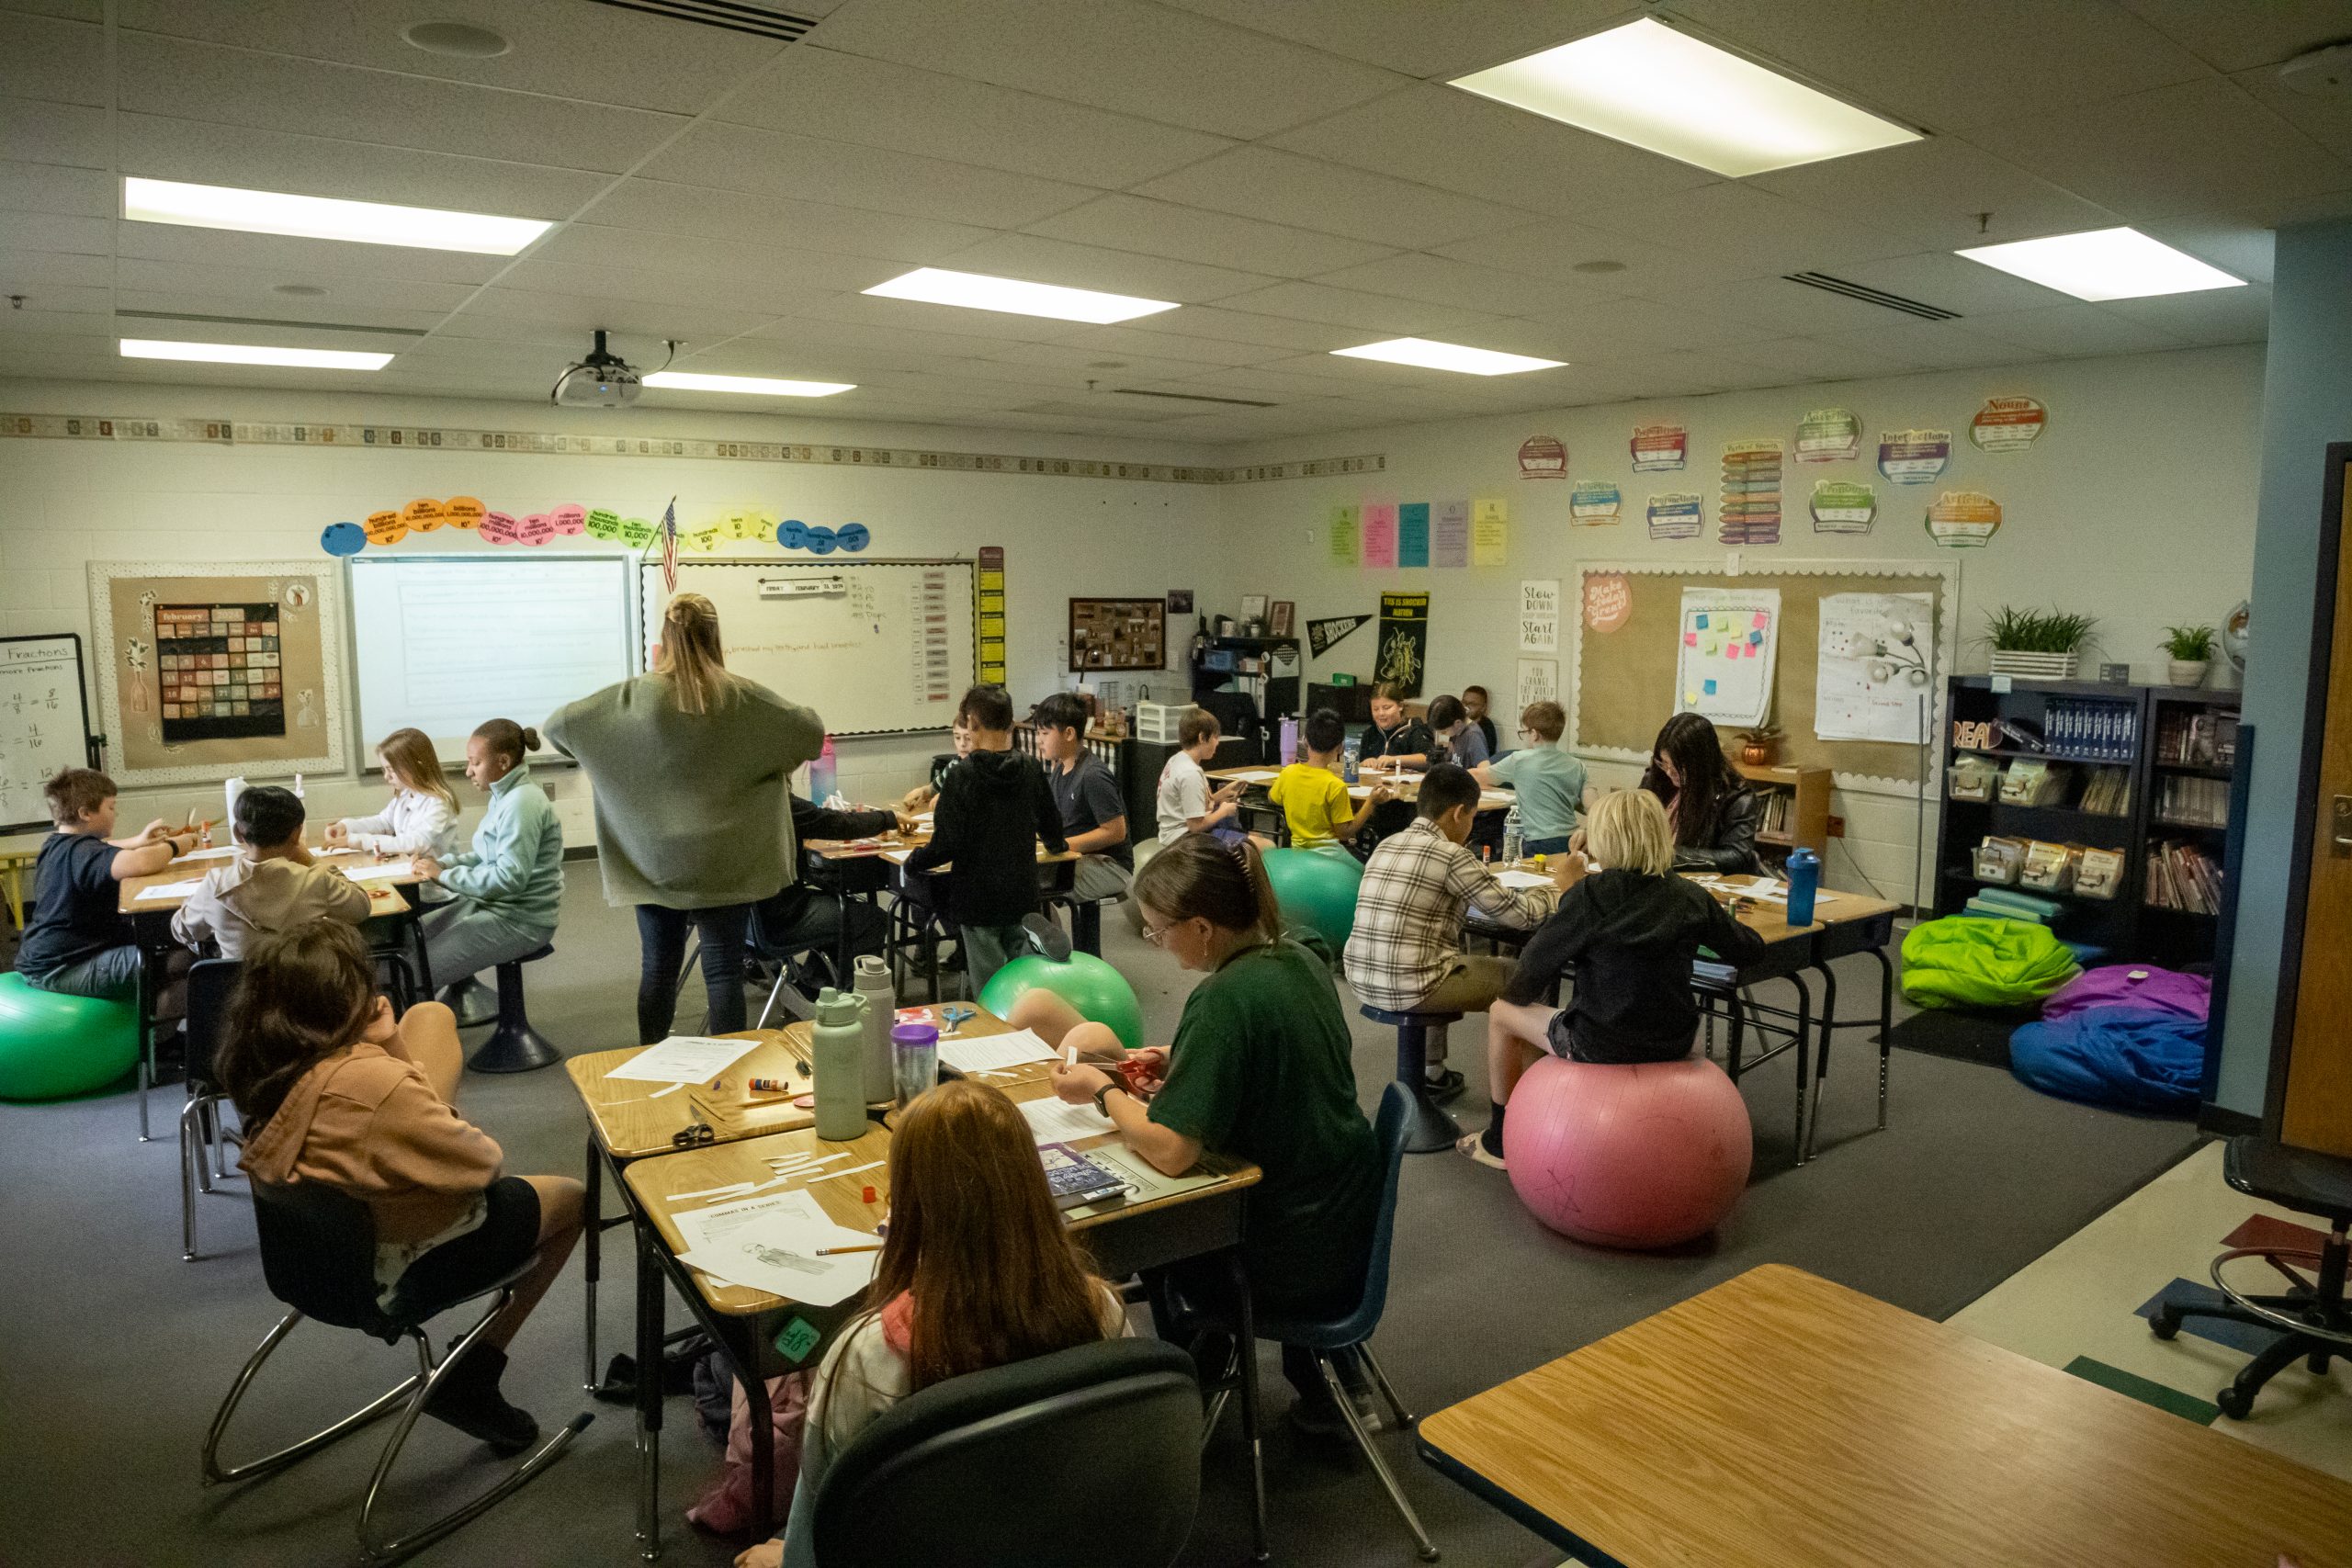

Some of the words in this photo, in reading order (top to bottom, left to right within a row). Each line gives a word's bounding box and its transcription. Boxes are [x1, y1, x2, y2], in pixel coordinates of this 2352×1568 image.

[1988, 399, 2030, 411] Nouns
[413, 507, 436, 515] billions
[593, 510, 618, 521] hundred
[368, 513, 396, 524] hundred
[373, 519, 396, 529] billions
[488, 512, 514, 525] hundred
[488, 518, 512, 530] millions
[589, 514, 619, 526] thousands
[524, 522, 547, 530] millions
[588, 521, 617, 534] 100,000
[623, 524, 652, 534] thousands
[520, 526, 554, 538] 10,000,000
[624, 530, 649, 540] 10,000
[693, 528, 718, 537] hundreds
[1524, 586, 1555, 599] Slow
[1589, 580, 1622, 601] Make
[1526, 599, 1553, 610] DOWN
[163, 613, 204, 621] february
[1323, 618, 1356, 643] SHOCKERS
[1522, 620, 1553, 634] Start
[1524, 634, 1554, 645] AGAIN
[8, 648, 68, 660] Fractions
[1532, 667, 1544, 677] YOU
[1525, 677, 1548, 686] CHANGE
[49, 688, 55, 697] 8
[218, 689, 228, 697] 21
[267, 686, 277, 694] 24
[1534, 685, 1555, 695] WORLD
[13, 693, 21, 701] 4
[29, 723, 38, 736] 4
[29, 739, 42, 749] 16
[710, 1208, 739, 1219] COMMAS
[757, 1201, 780, 1210] SERIES
